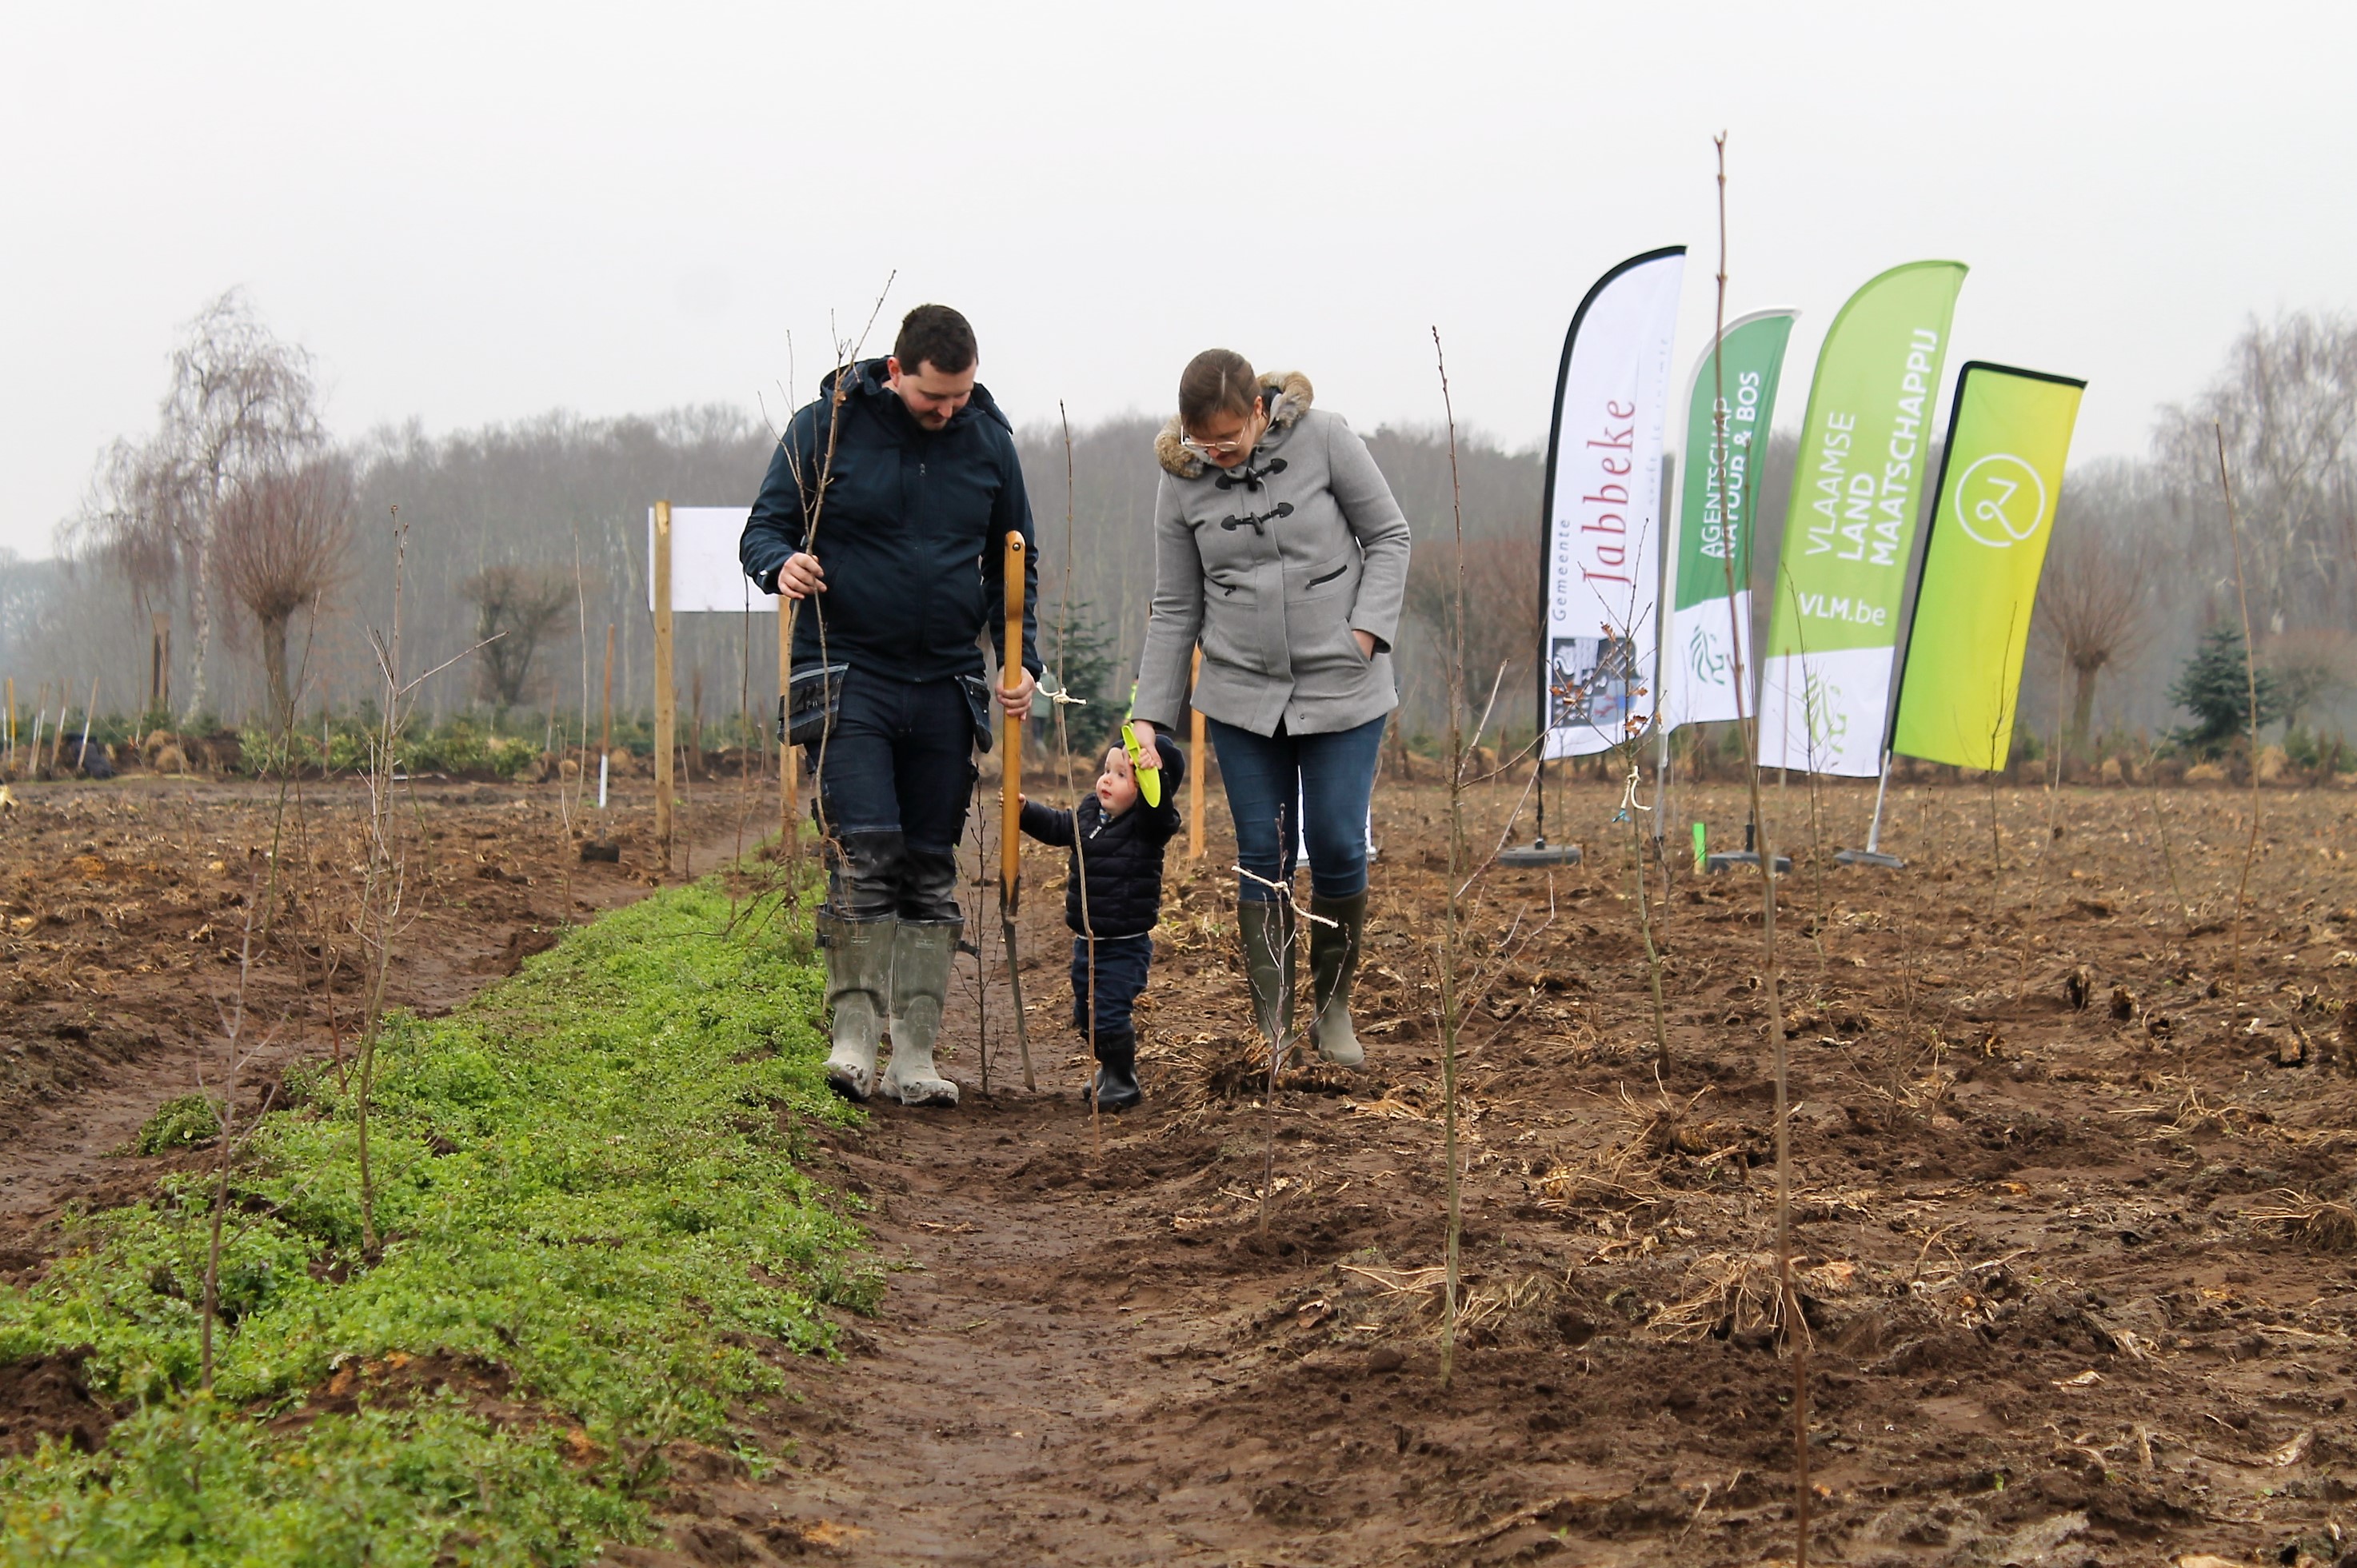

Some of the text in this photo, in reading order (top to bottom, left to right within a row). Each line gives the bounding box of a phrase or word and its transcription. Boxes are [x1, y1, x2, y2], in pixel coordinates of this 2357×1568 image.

[1733, 430, 1752, 447] &
[1736, 371, 1760, 422] BOS
[1580, 400, 1636, 590] Jabbeke
[1805, 412, 1856, 556] VLAAMSE
[1870, 329, 1938, 566] MAATSCHAPPIJ
[1837, 473, 1876, 561] LAND
[1552, 519, 1571, 622] Gemeente
[1800, 592, 1887, 626] VLM.be
